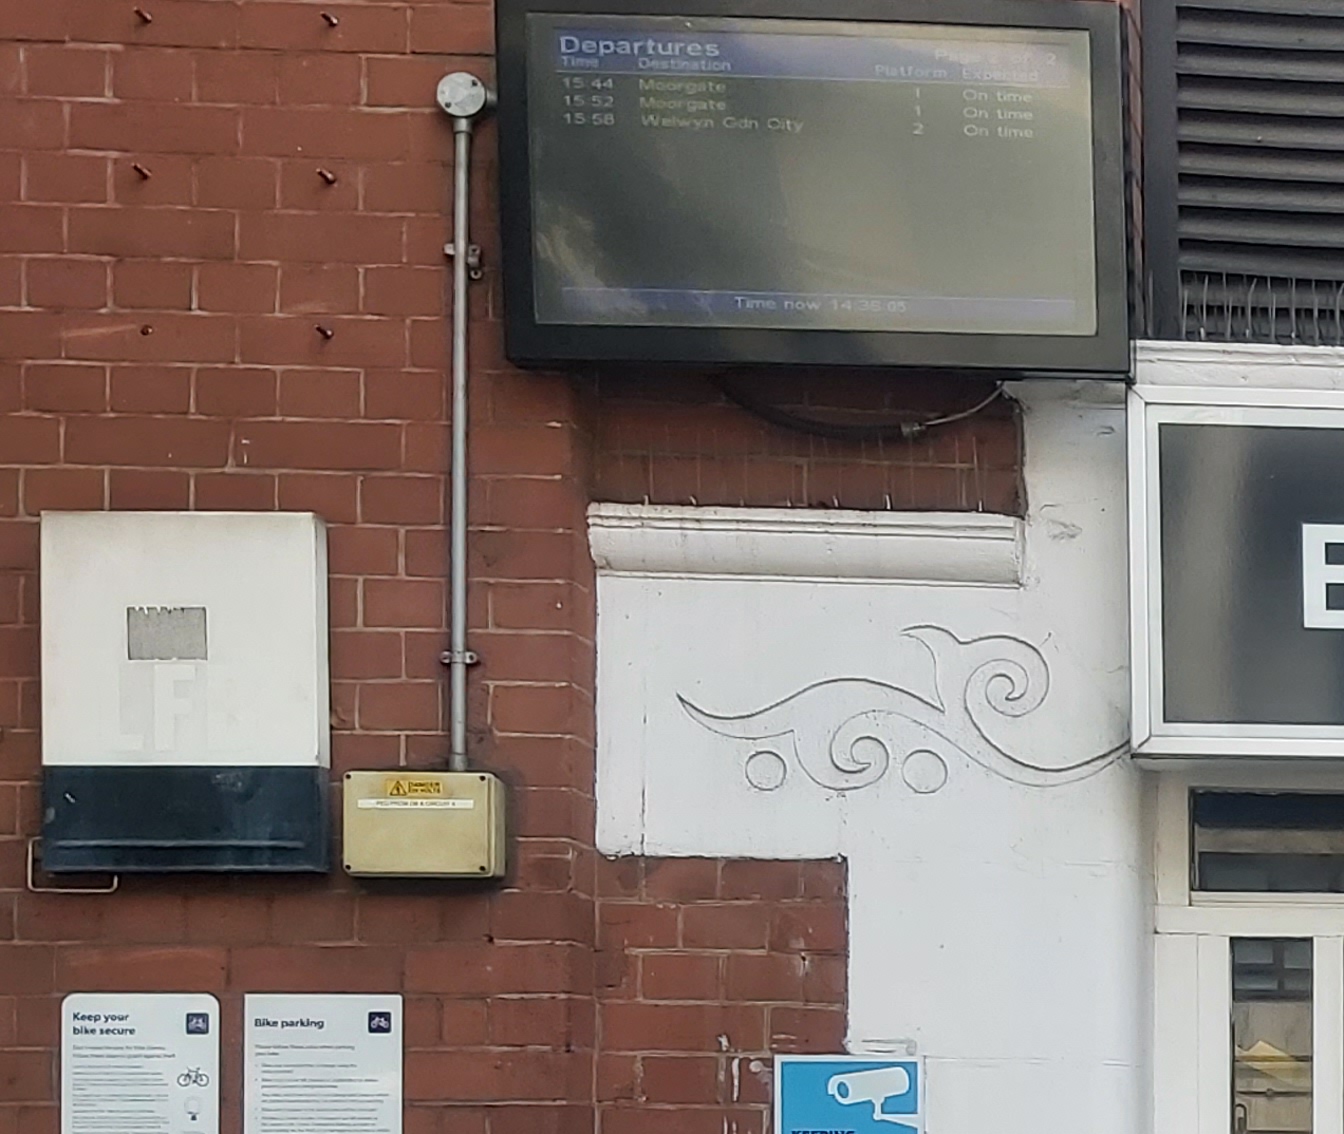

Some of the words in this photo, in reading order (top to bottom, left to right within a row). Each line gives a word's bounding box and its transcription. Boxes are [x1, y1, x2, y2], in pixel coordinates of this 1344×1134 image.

[559, 36, 721, 58] Departures
[1046, 53, 1058, 65] 2
[561, 55, 600, 67] Time
[638, 58, 732, 72] Destination
[874, 65, 947, 78] Platform
[962, 68, 1039, 83] Expected
[638, 78, 727, 94] Moorgate
[962, 89, 988, 100] On
[996, 89, 1034, 103] time
[638, 97, 727, 112] Moorgate
[963, 107, 989, 119] On
[996, 107, 1034, 120] time
[641, 114, 714, 130] Welwyn
[722, 116, 759, 129] Gdn
[768, 117, 805, 133] City
[912, 123, 925, 135] 2
[963, 125, 990, 137] On
[997, 124, 1034, 138] time
[734, 296, 777, 310] Time
[784, 300, 820, 311] now
[72, 1012, 101, 1024] Keep
[104, 1014, 129, 1024] your
[254, 1018, 279, 1028] Bike
[281, 1018, 325, 1030] parking
[72, 1026, 97, 1036] bike
[99, 1027, 136, 1036] secure
